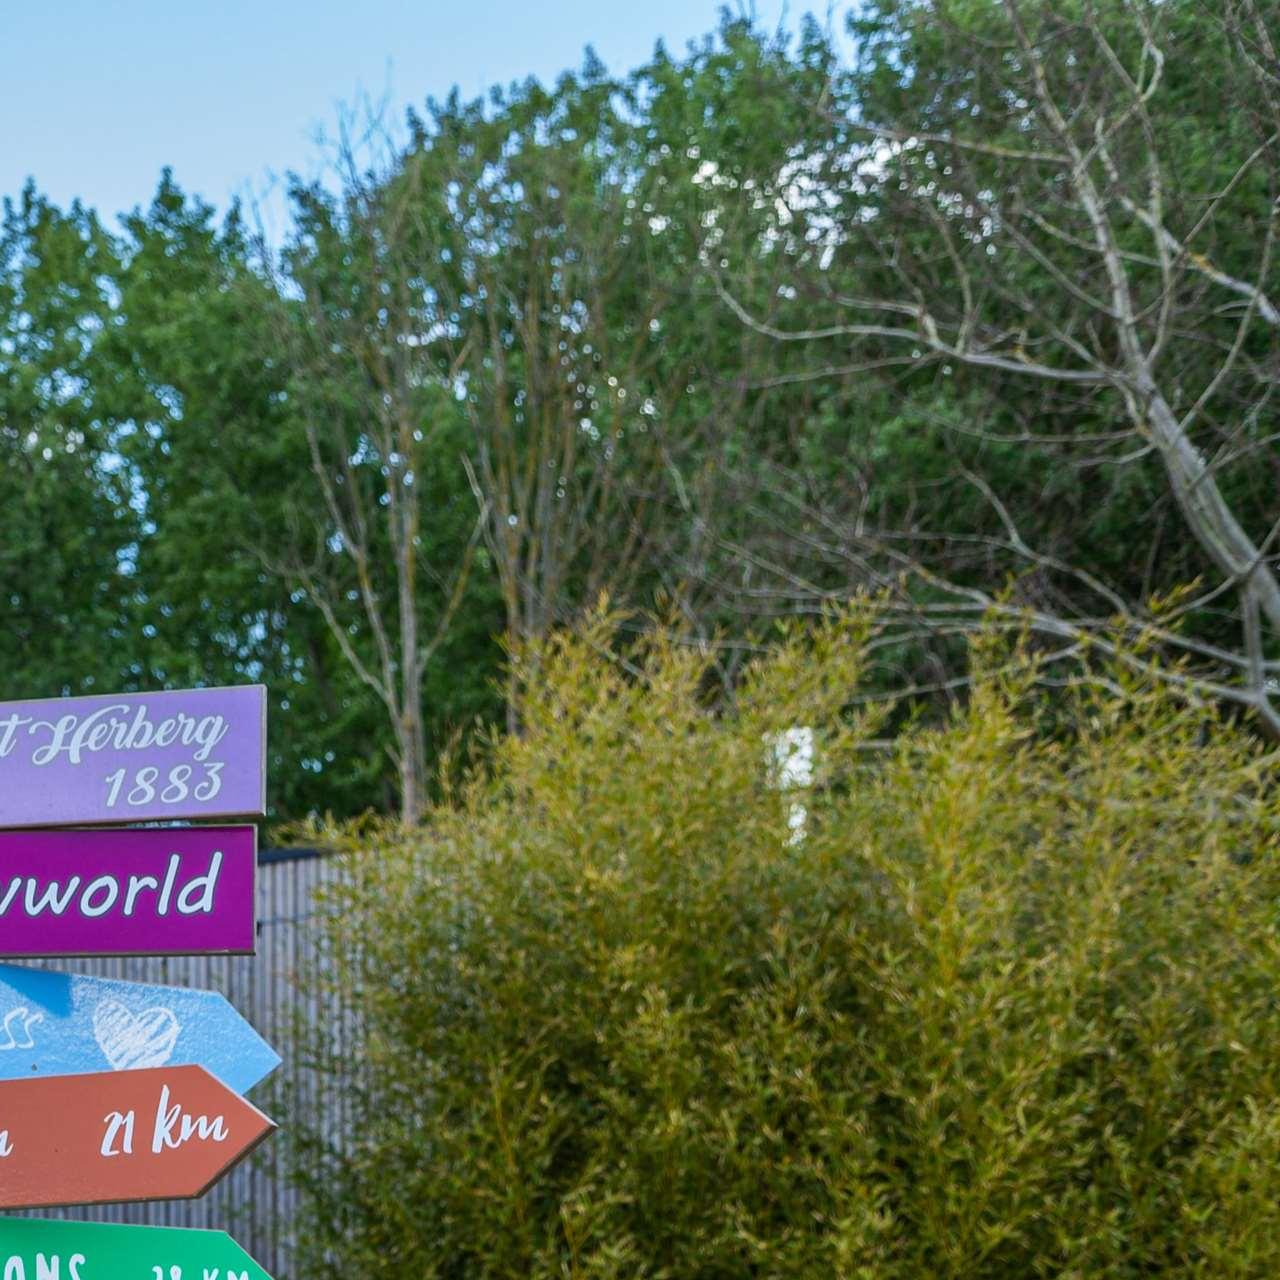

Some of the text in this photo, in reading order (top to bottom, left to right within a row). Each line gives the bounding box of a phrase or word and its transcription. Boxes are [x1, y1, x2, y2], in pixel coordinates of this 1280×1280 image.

[28, 704, 230, 766] Herberg
[104, 762, 225, 808] 1883
[100, 1109, 135, 1157] 21
[151, 1084, 230, 1153] km
